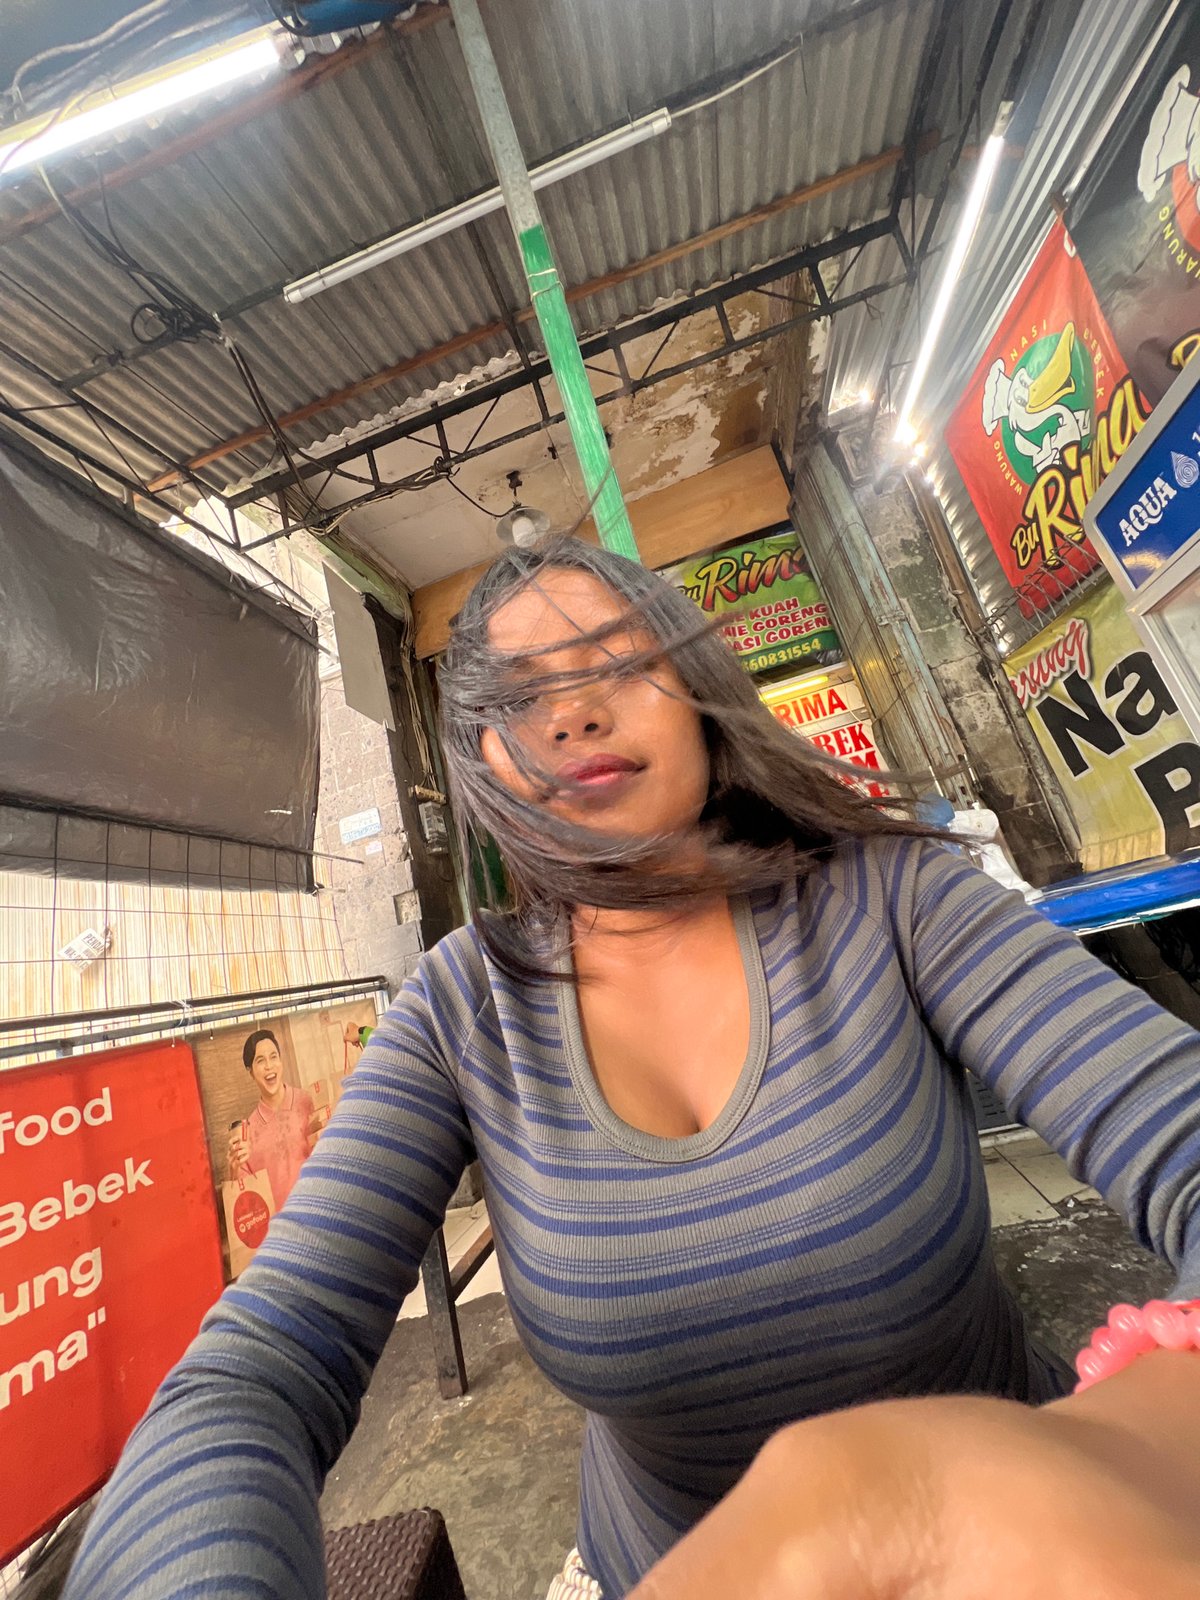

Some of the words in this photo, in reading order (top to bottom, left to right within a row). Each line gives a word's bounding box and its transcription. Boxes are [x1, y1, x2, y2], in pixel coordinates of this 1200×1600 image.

[1010, 320, 1046, 361] NASI
[994, 441, 1023, 495] WARUNG
[1119, 477, 1177, 546] AQUA
[1011, 522, 1040, 568] Bu
[676, 585, 701, 602] u
[749, 598, 798, 620] KUAH
[752, 603, 828, 632] GORENG
[727, 636, 761, 651] ASI
[773, 688, 847, 727] RIMA
[0, 1246, 102, 1326] ung
